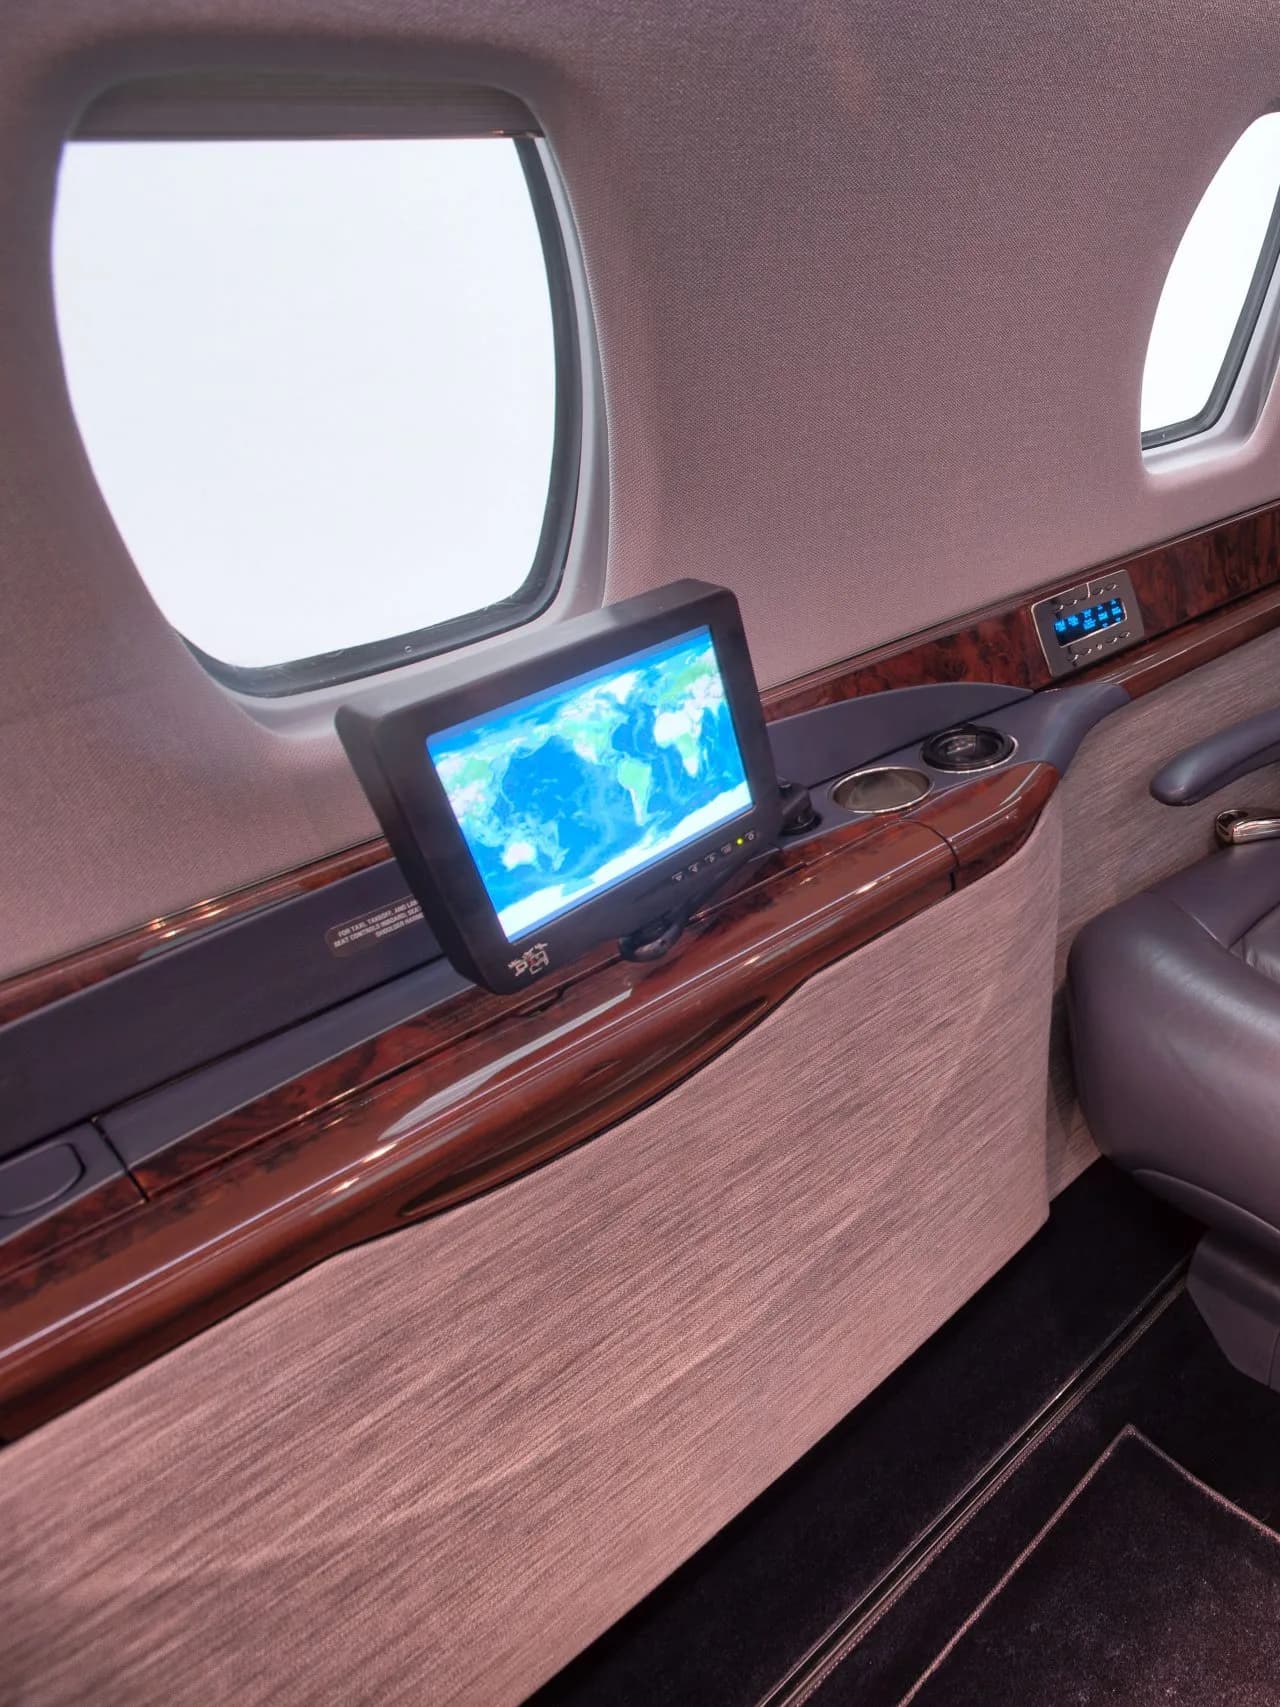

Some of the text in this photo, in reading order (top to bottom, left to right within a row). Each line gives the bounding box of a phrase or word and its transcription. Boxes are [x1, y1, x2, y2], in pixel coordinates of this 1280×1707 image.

[338, 928, 351, 937] FOR
[394, 904, 407, 913] AND
[334, 937, 349, 948] SEAT
[350, 923, 380, 940] CONTROLS
